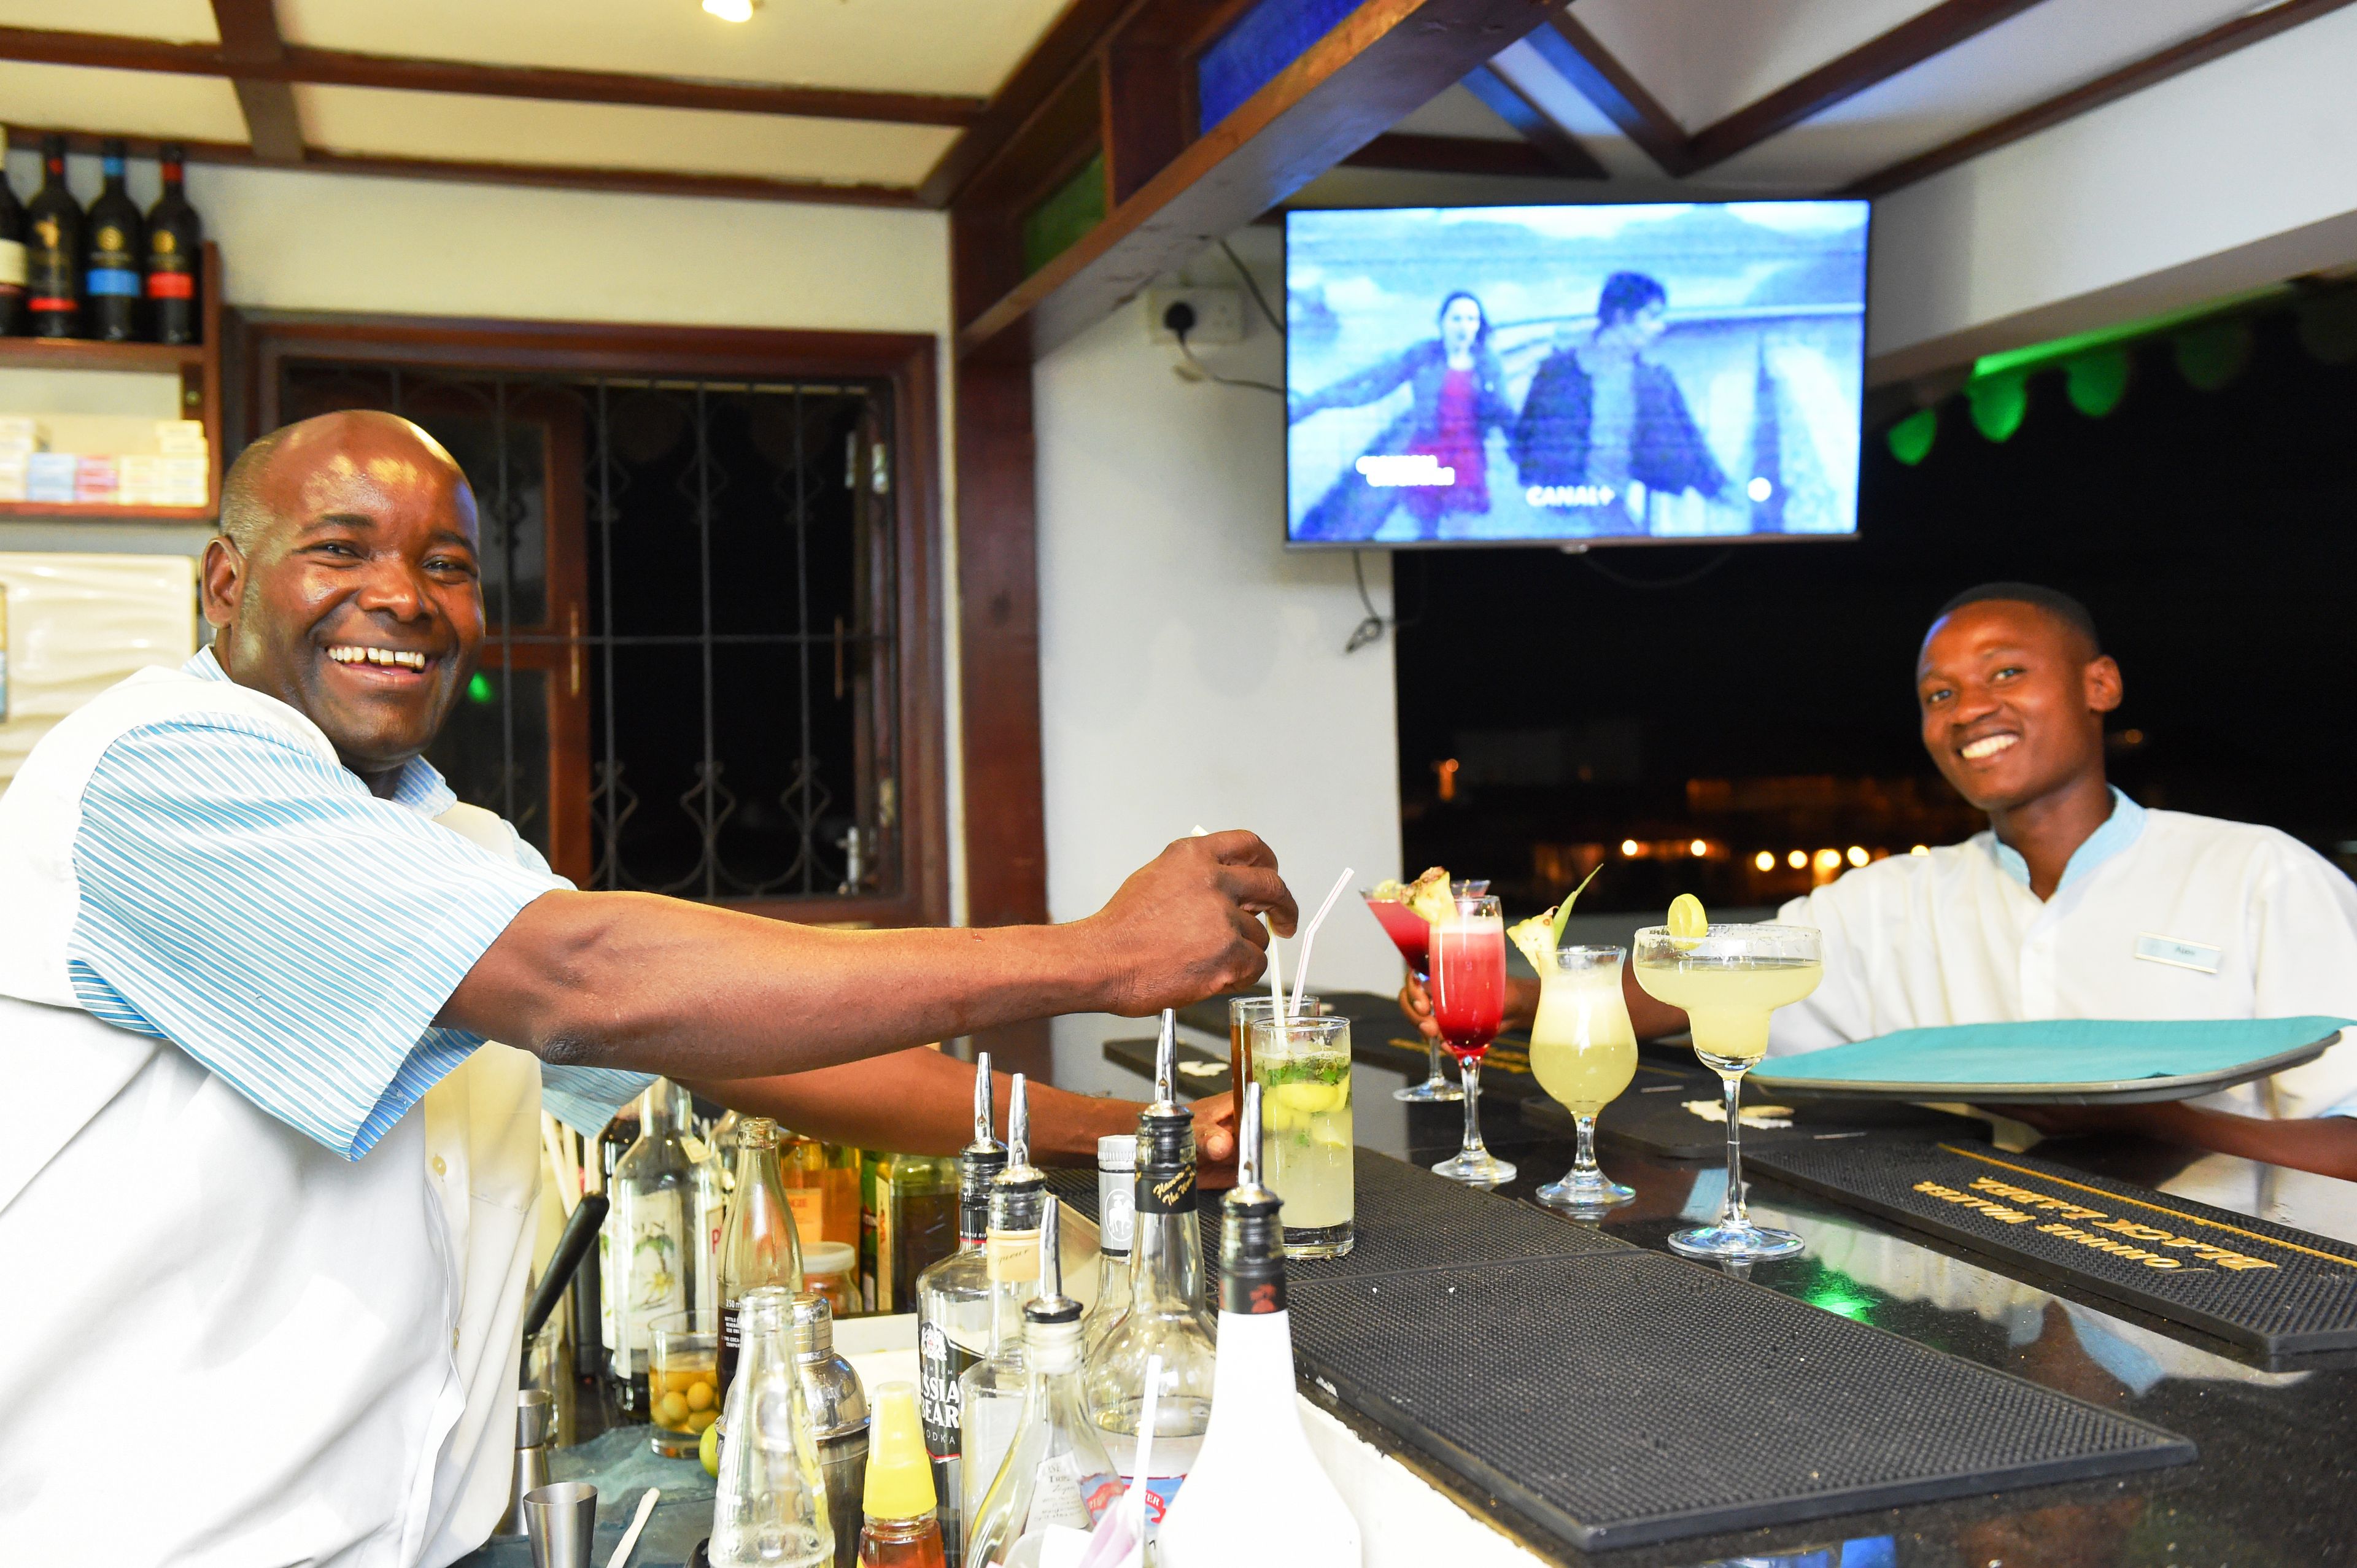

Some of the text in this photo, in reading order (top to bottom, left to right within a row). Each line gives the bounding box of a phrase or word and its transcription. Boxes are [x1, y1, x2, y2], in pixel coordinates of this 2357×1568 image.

[1913, 1181, 2037, 1224] WALKER
[1968, 1176, 2278, 1271] BLACK LABEL
[726, 1299, 735, 1308] 350
